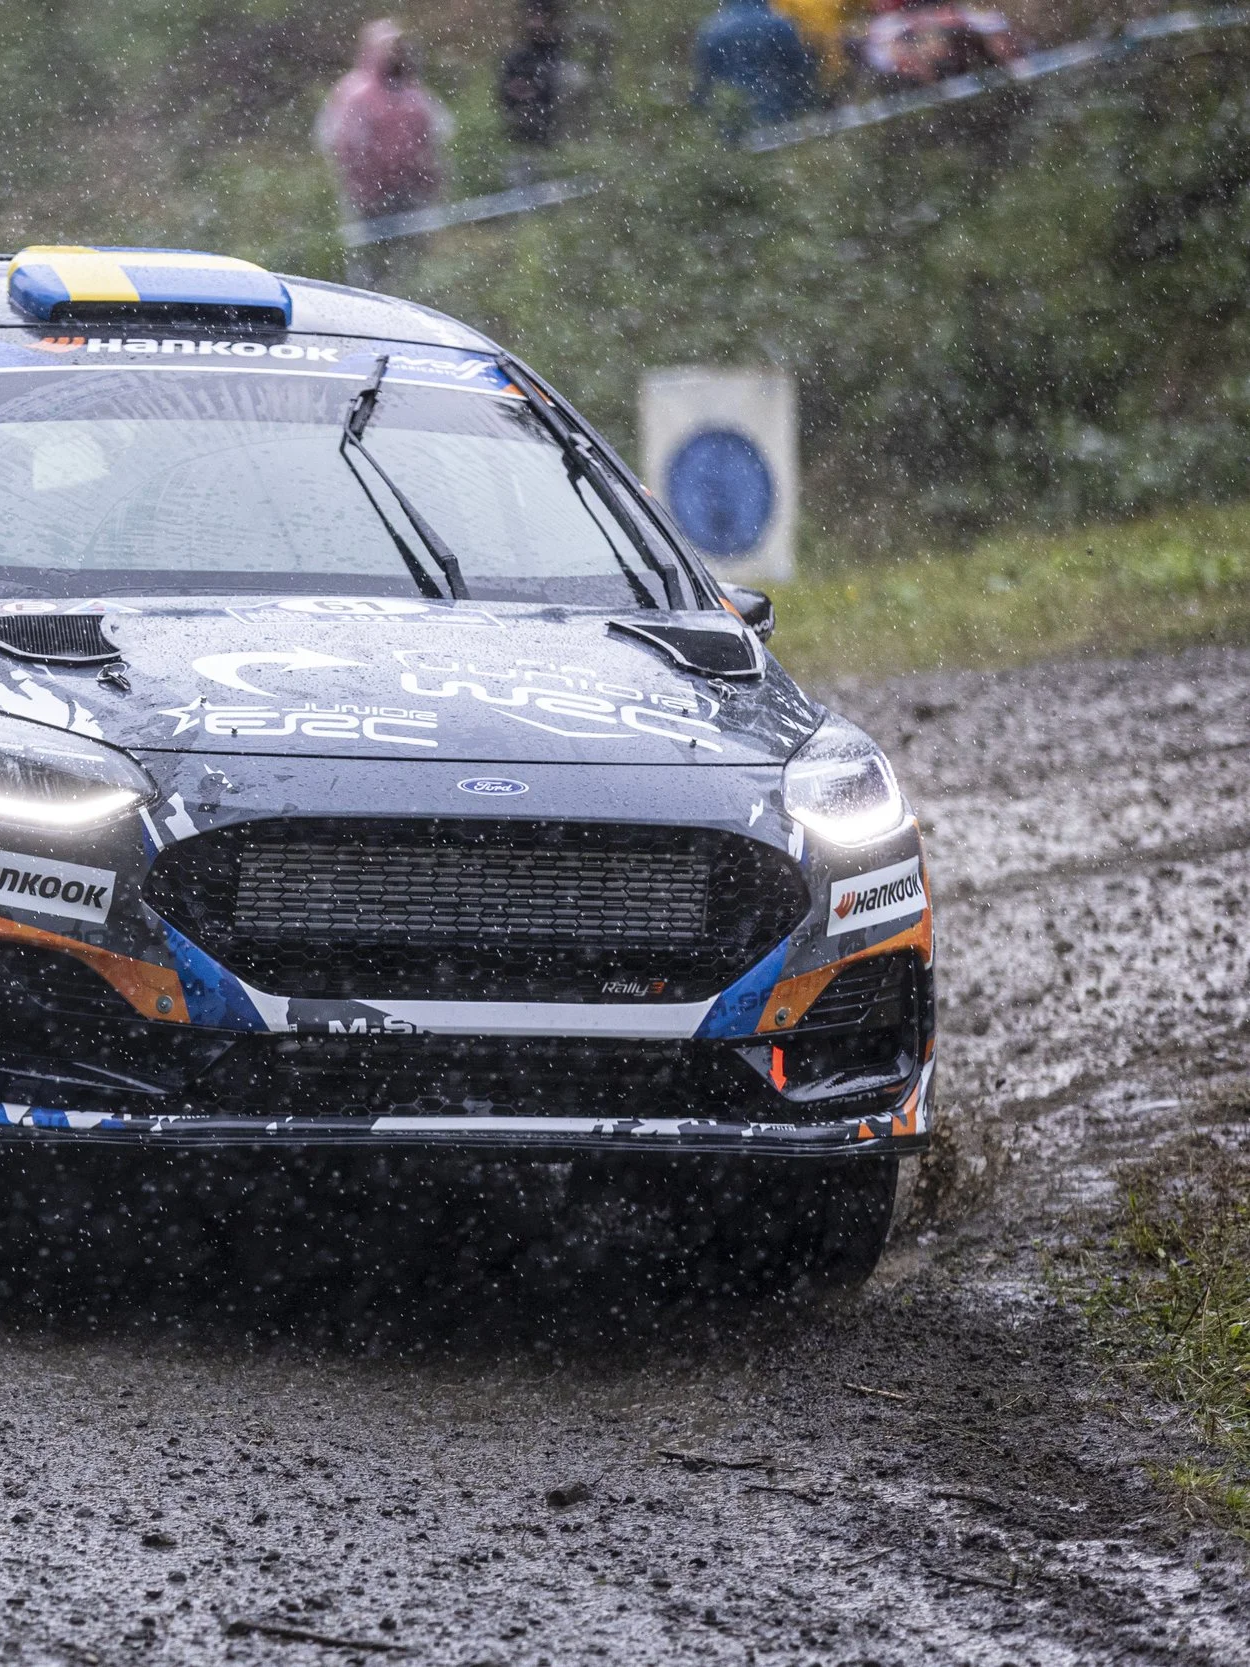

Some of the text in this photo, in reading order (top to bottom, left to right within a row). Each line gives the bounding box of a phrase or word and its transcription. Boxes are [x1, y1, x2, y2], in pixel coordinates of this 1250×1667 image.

[312, 600, 387, 612] 61
[281, 702, 439, 722] JUNIOR
[400, 671, 724, 754] WRC
[474, 781, 513, 792] Ford
